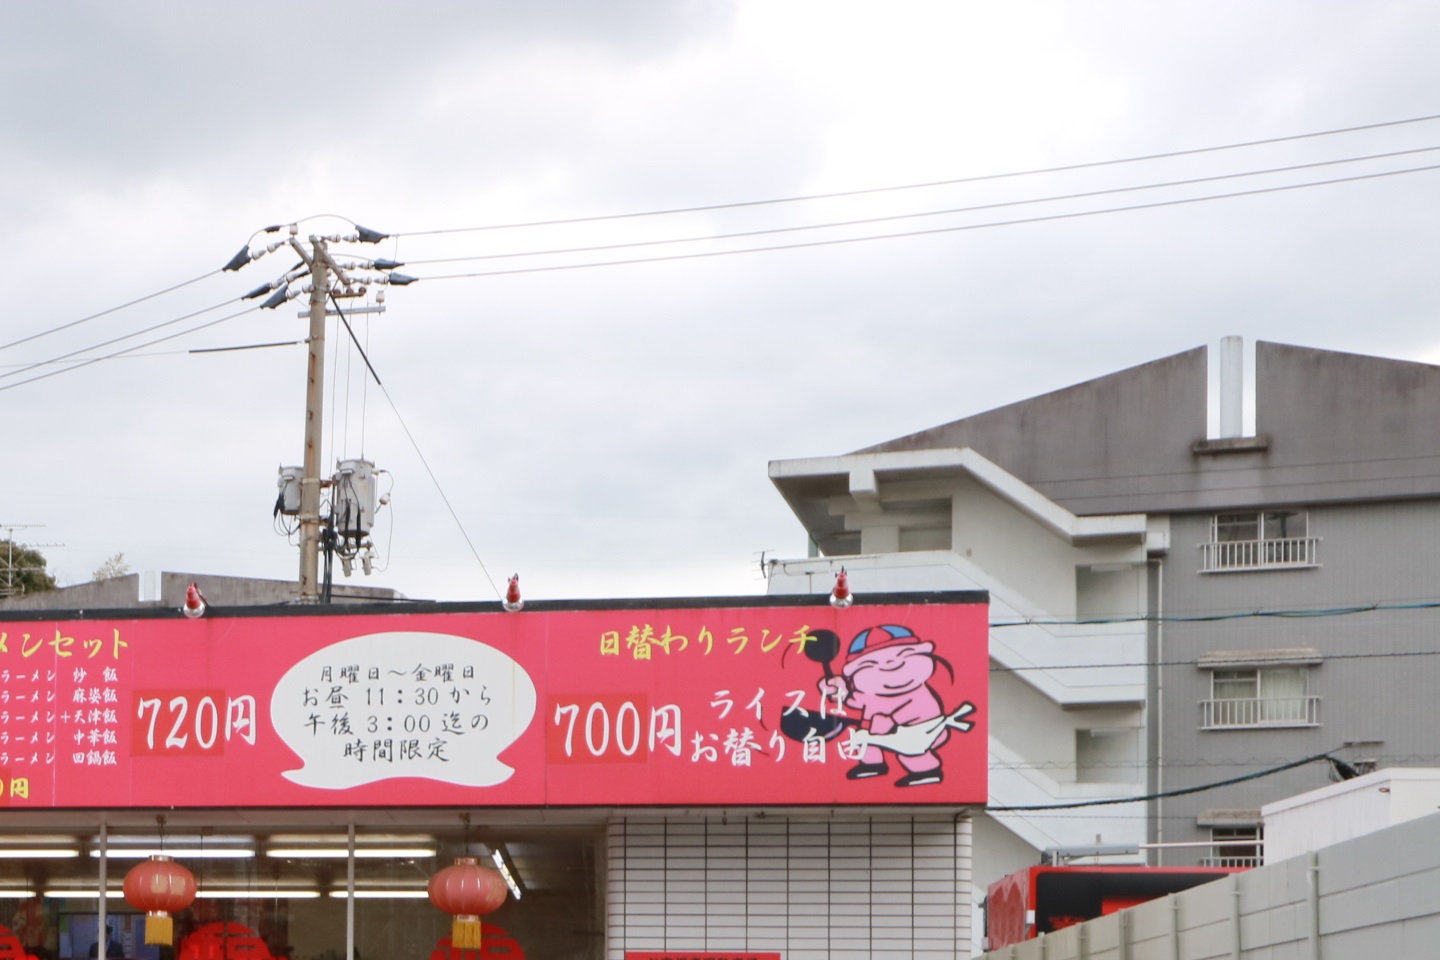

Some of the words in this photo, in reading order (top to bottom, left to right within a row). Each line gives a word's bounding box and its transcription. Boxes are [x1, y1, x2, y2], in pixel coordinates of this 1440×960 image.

[600, 624, 817, 661] 日替わりランチ
[137, 694, 257, 750] 720円
[710, 689, 849, 720] ライスは
[73, 728, 118, 745] 中華飯
[554, 701, 682, 757] 700円
[690, 727, 868, 768] お替り自由
[343, 738, 450, 763] 時間限定
